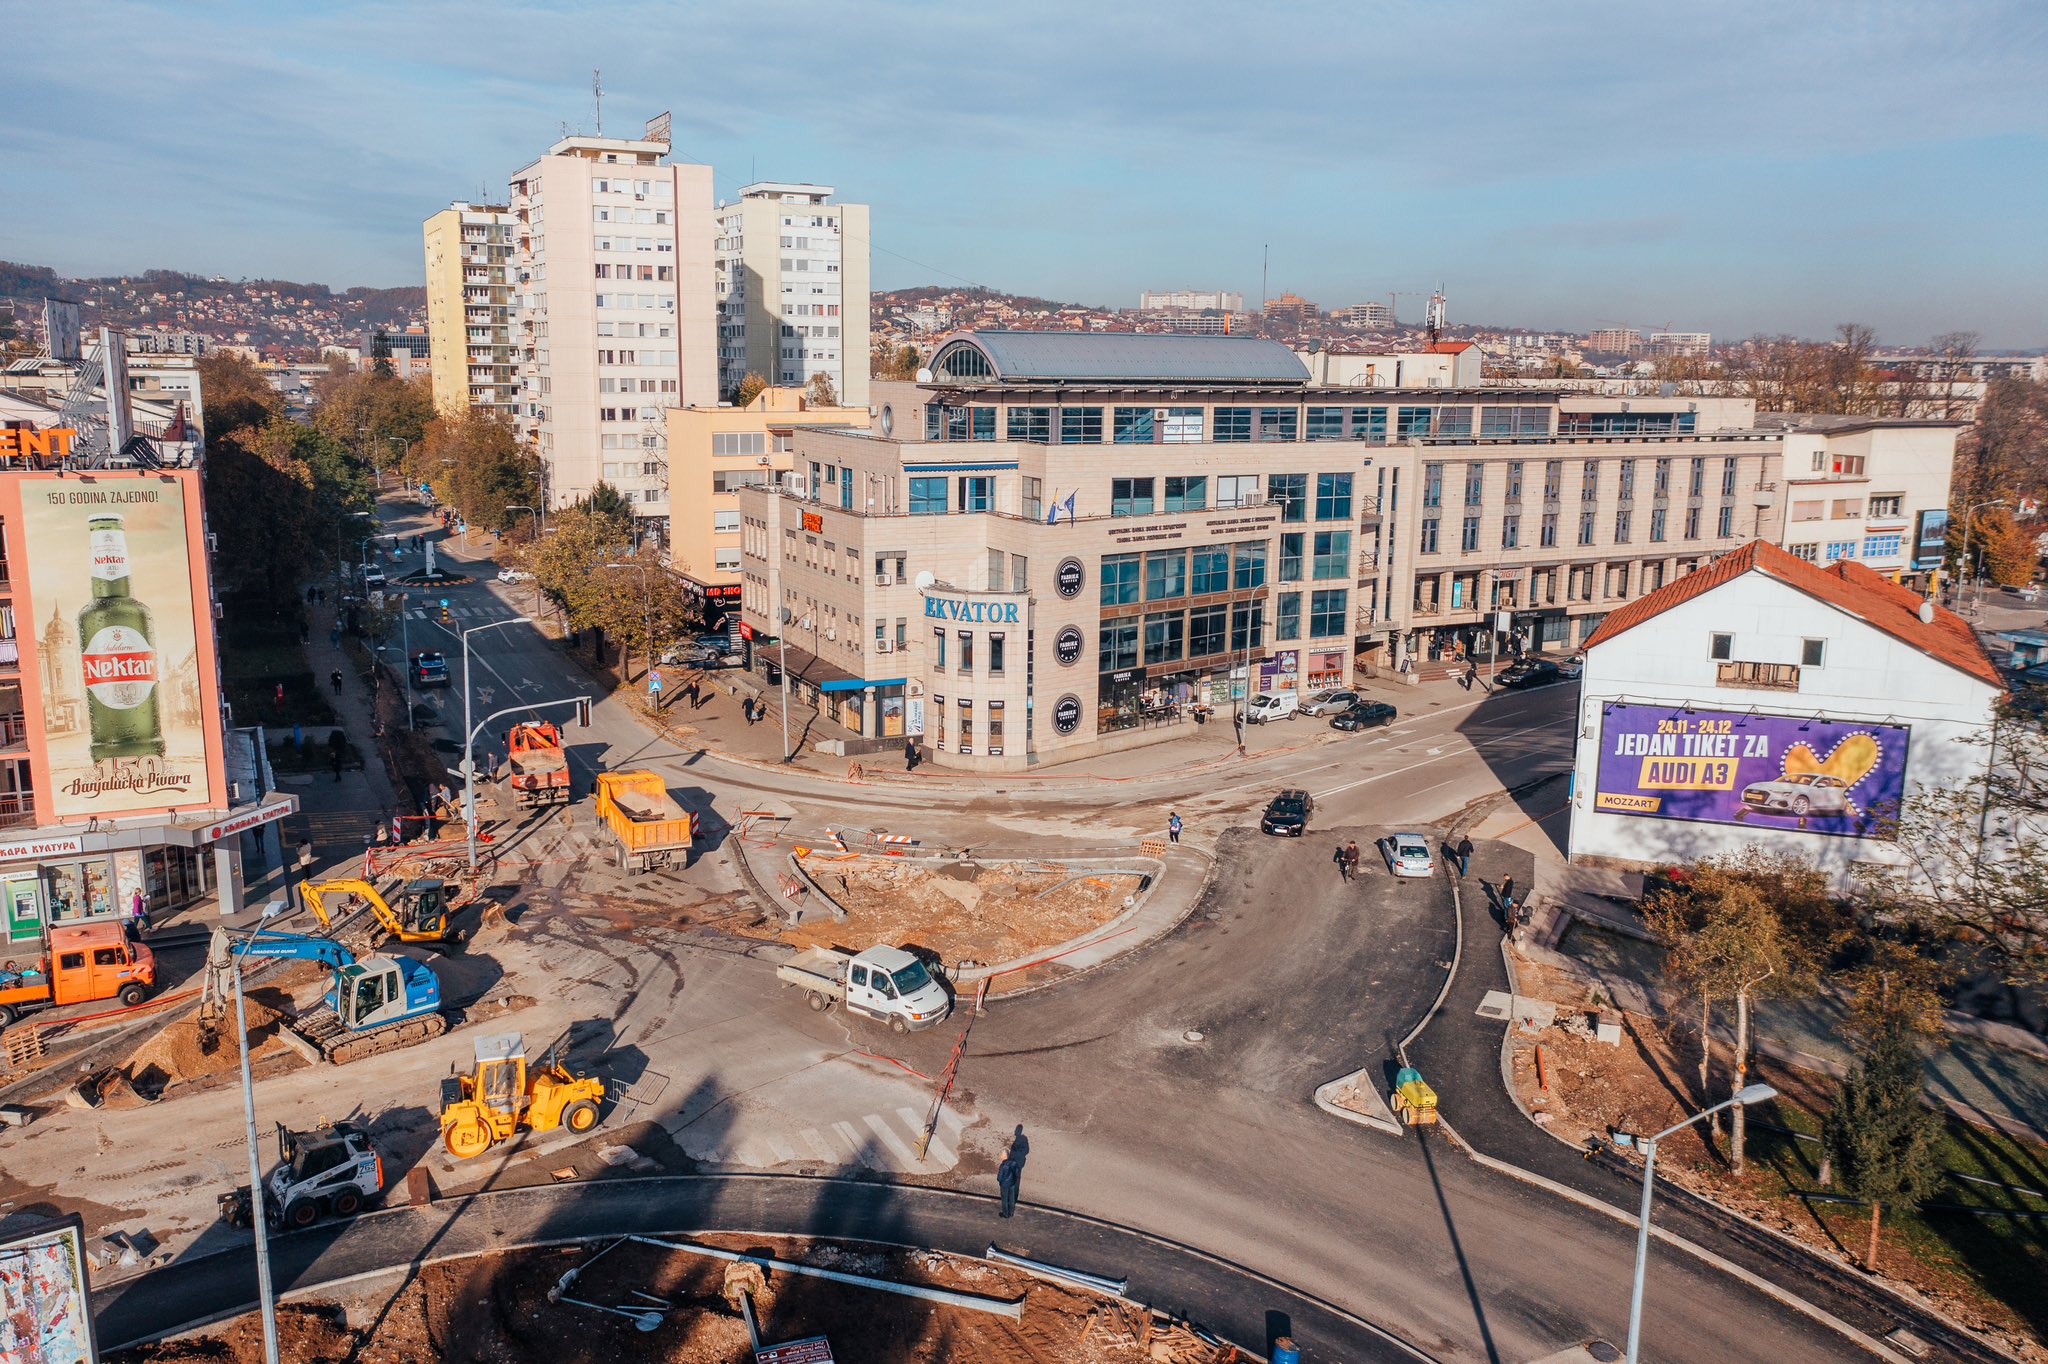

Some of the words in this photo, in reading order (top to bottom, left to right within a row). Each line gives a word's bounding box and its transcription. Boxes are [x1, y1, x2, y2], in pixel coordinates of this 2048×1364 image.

[47, 492, 65, 504] 150
[69, 491, 107, 504] GODINA
[110, 491, 159, 504] ZAJEDNO!
[94, 555, 126, 565] Nektar
[723, 587, 742, 596] SHO
[924, 596, 1020, 623] EKVATOR
[85, 656, 154, 679] Nektar
[1658, 720, 1688, 734] 24.11
[1698, 720, 1732, 734] 24.12
[1614, 733, 1677, 756] JEDAN
[1683, 734, 1739, 757] TIKET
[1743, 735, 1769, 757] ZA
[1648, 762, 1697, 784] AUDI
[1701, 763, 1729, 785] A3
[147, 772, 192, 789] Pivara
[1604, 796, 1654, 808] MOZZART
[32, 842, 76, 853] КУЛТУРА
[360, 1163, 376, 1172] 763
